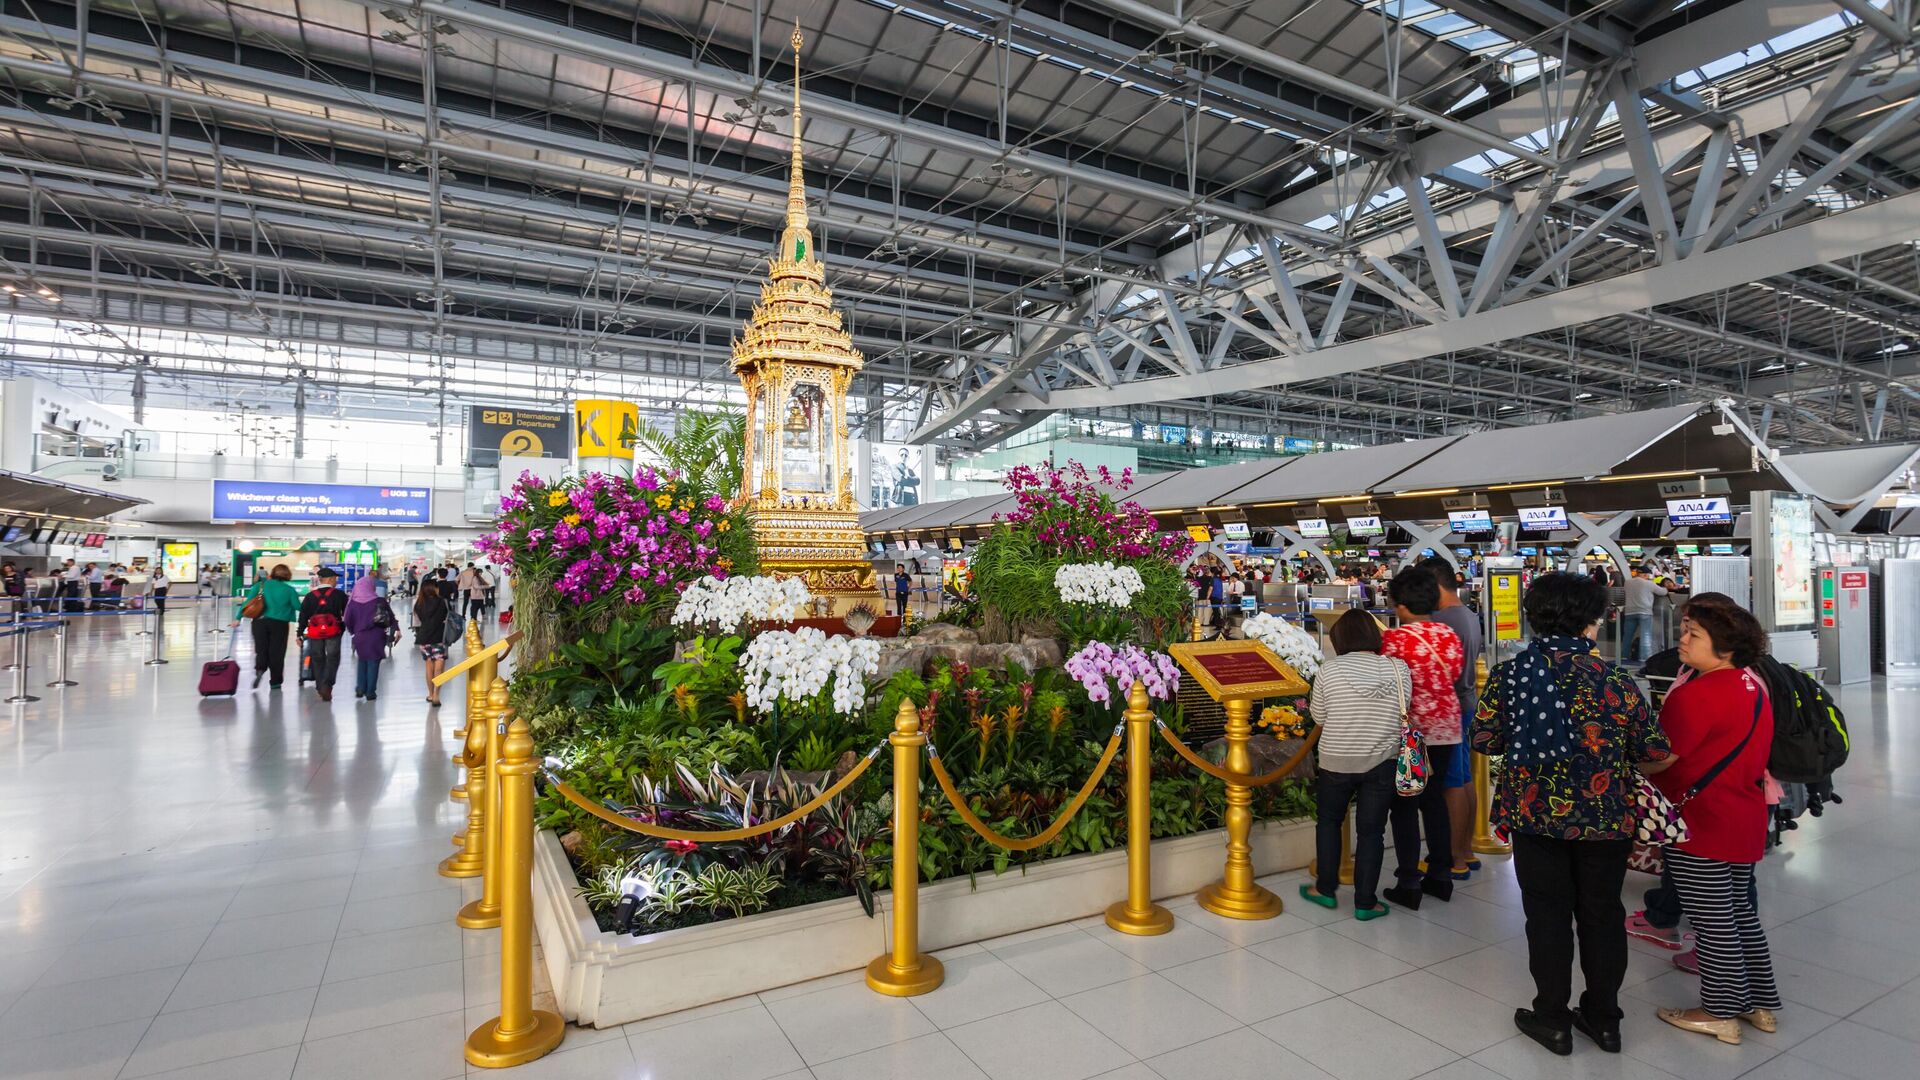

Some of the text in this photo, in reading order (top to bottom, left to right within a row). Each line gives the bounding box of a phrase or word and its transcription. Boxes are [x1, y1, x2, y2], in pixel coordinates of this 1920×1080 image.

[516, 411, 561, 422] International
[516, 419, 556, 429] Departures
[577, 409, 605, 448] K
[512, 435, 532, 456] 2
[1663, 484, 1685, 494] L01
[227, 492, 332, 505] Whichever class you fly,
[248, 505, 270, 514] your
[270, 504, 308, 514] MONEY
[308, 505, 327, 514] flies
[327, 506, 356, 515] FIRST
[356, 507, 389, 516] CLASS
[1677, 503, 1705, 513] ANA
[1527, 511, 1547, 519] ANA
[1353, 519, 1369, 527] ANA
